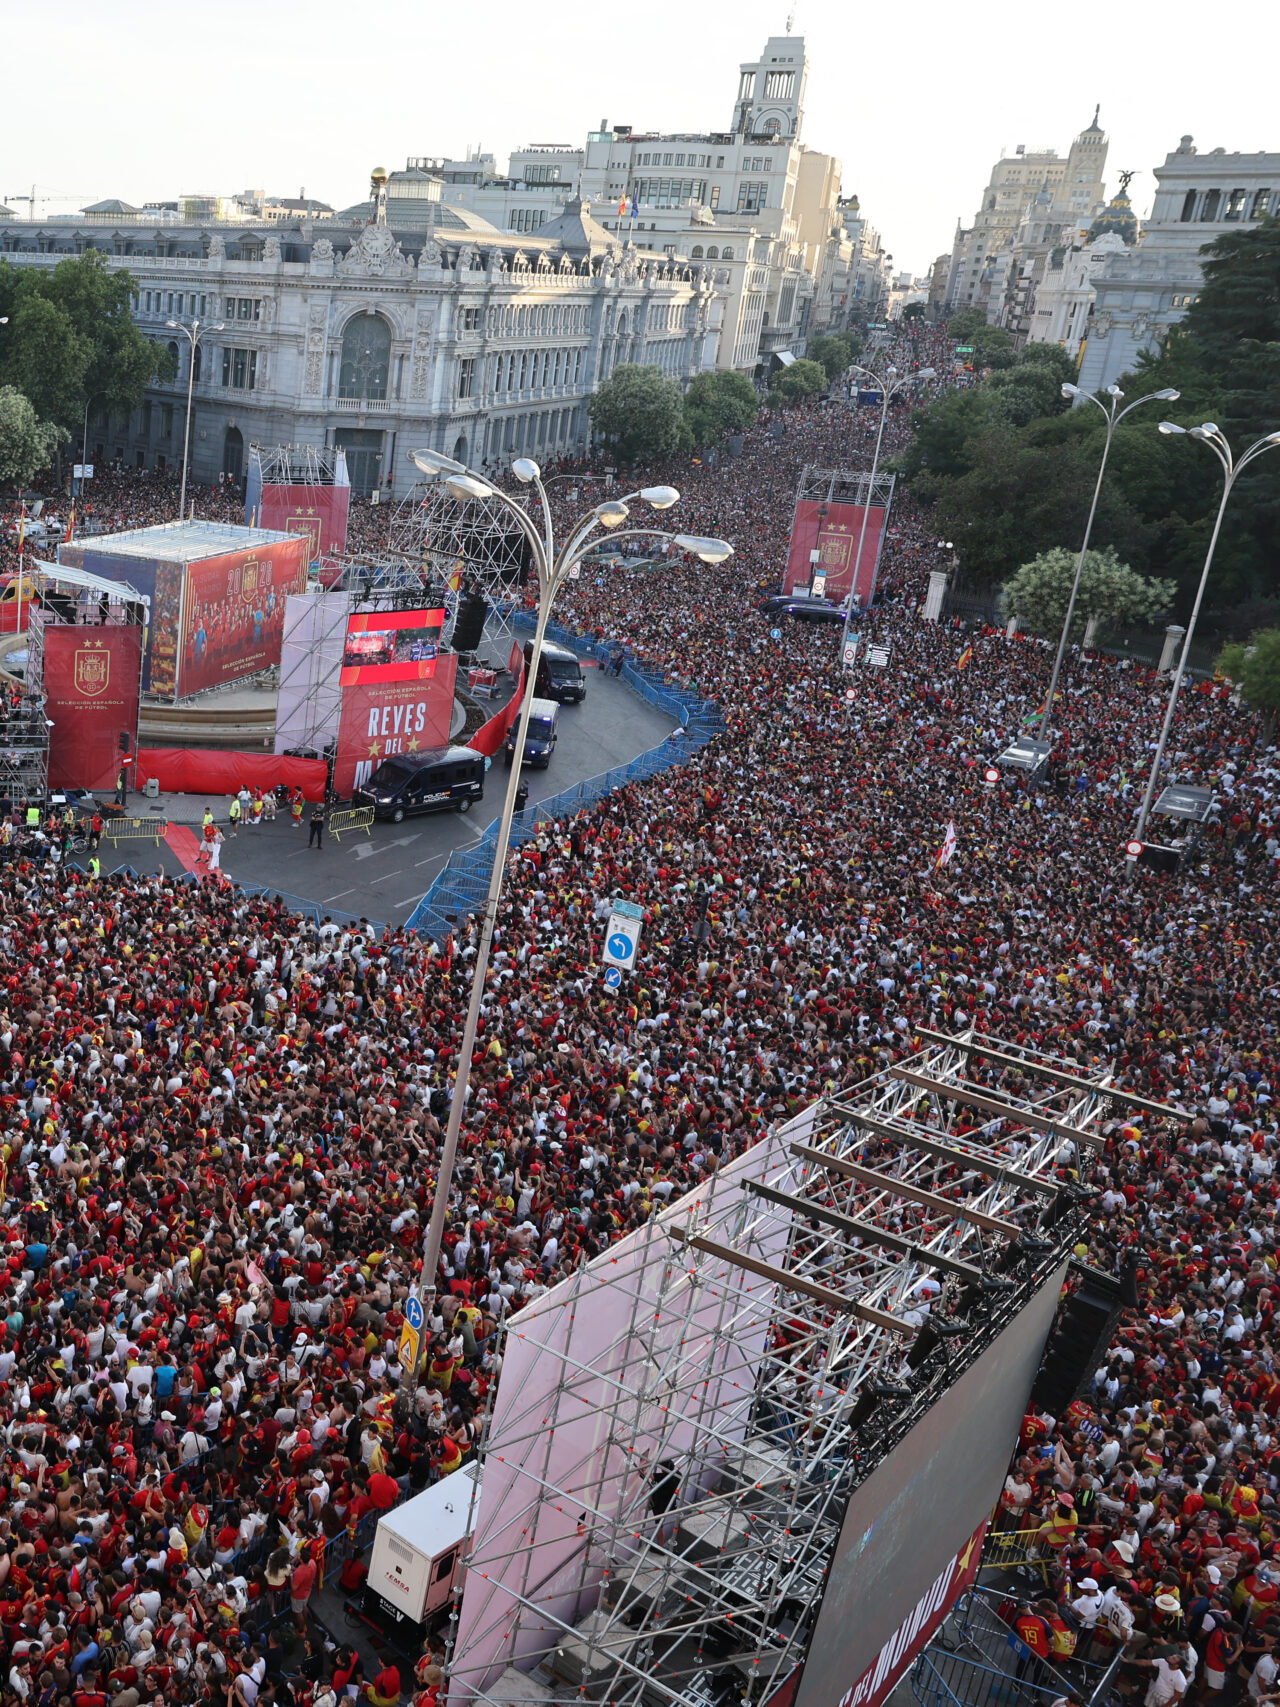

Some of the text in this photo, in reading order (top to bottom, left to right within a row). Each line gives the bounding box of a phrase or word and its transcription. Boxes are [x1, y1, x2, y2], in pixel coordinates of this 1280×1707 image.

[227, 567, 240, 596] 20
[368, 688, 400, 696] SELECCIÓN
[368, 703, 426, 737] REYES
[385, 738, 402, 755] DEL
[1025, 1426, 1035, 1438] 9
[8, 1605, 16, 1613] 10
[380, 1598, 396, 1614] STAGE
[396, 1610, 404, 1622] V
[867, 1554, 958, 1703] MUNDO
[1023, 1629, 1038, 1645] 19
